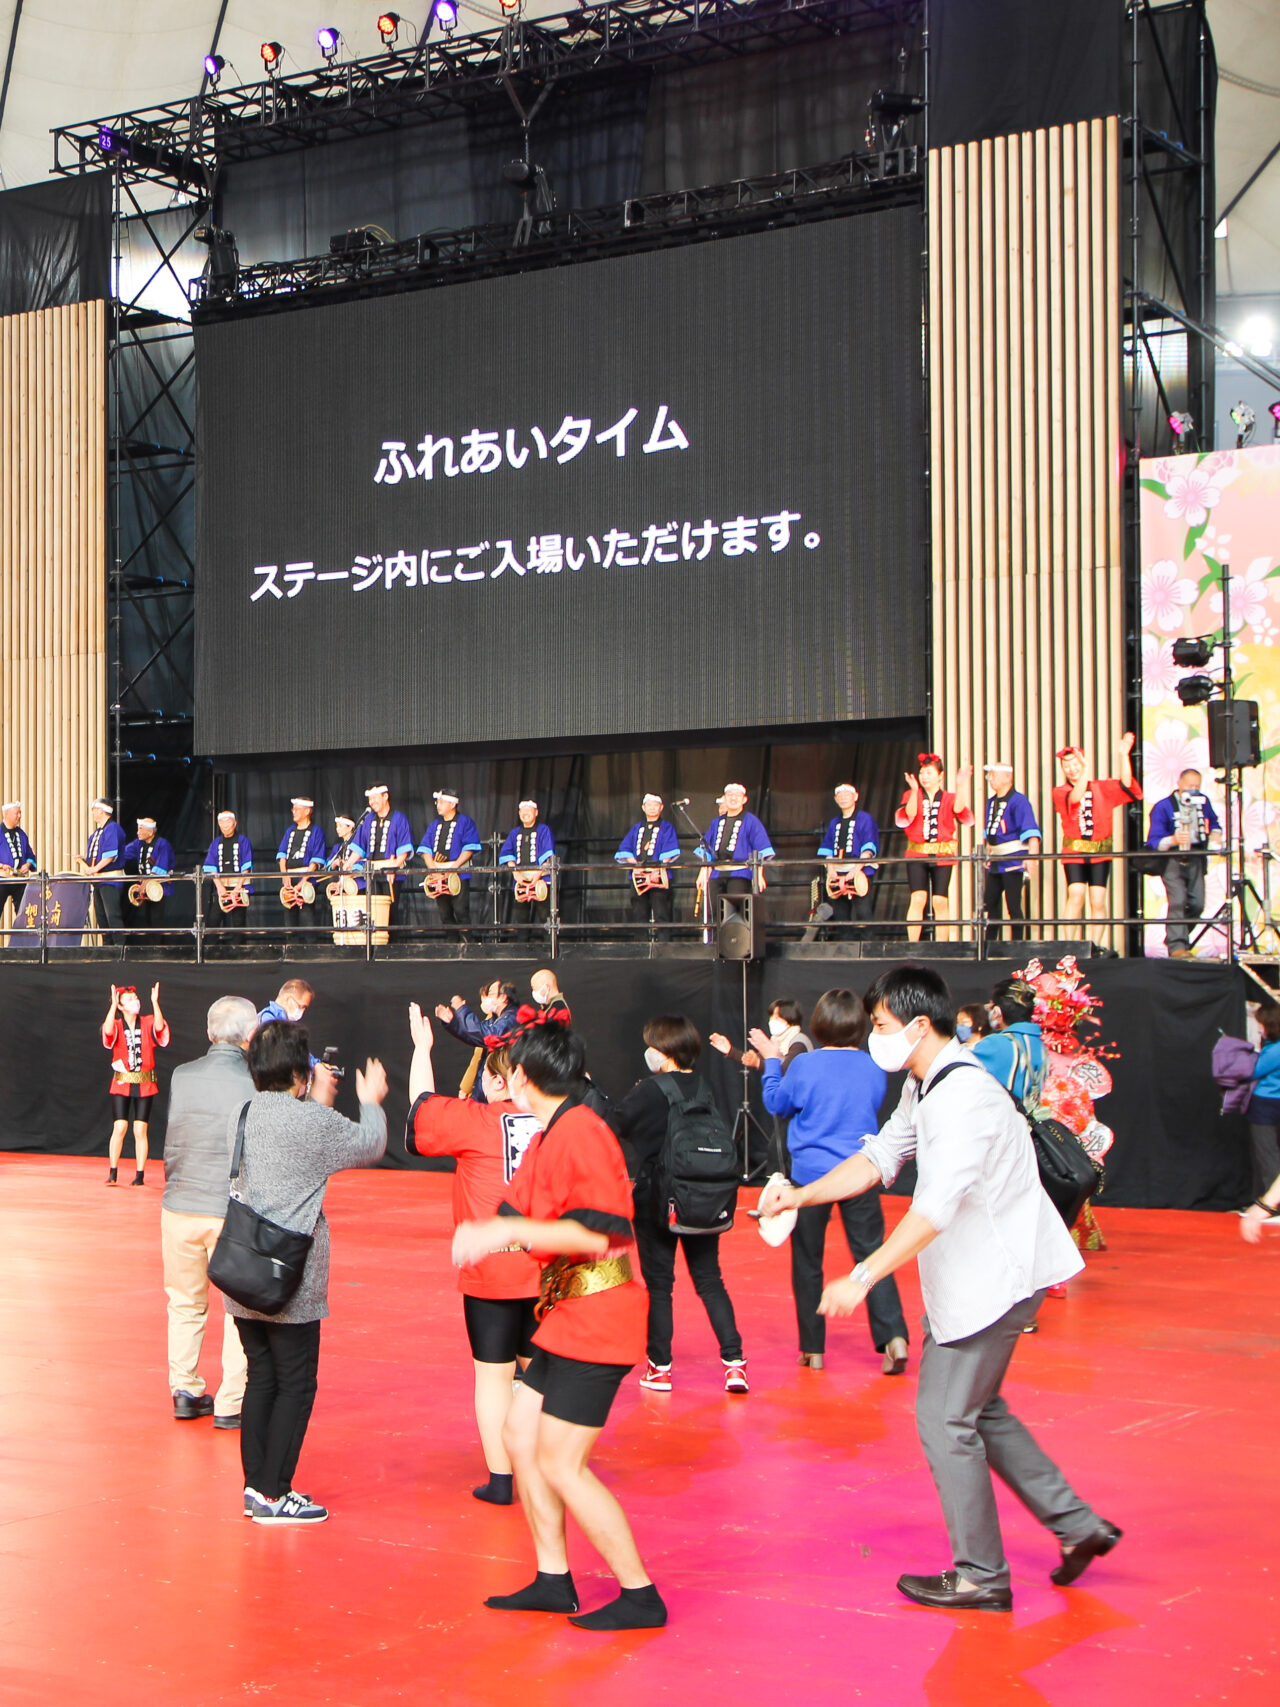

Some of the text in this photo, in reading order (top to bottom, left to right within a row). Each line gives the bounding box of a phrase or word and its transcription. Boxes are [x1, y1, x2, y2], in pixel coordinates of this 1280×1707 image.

[373, 404, 690, 485] ふれあいタイム
[249, 510, 821, 602] ステージ内にご入場いただけます。
[283, 1500, 300, 1515] N
